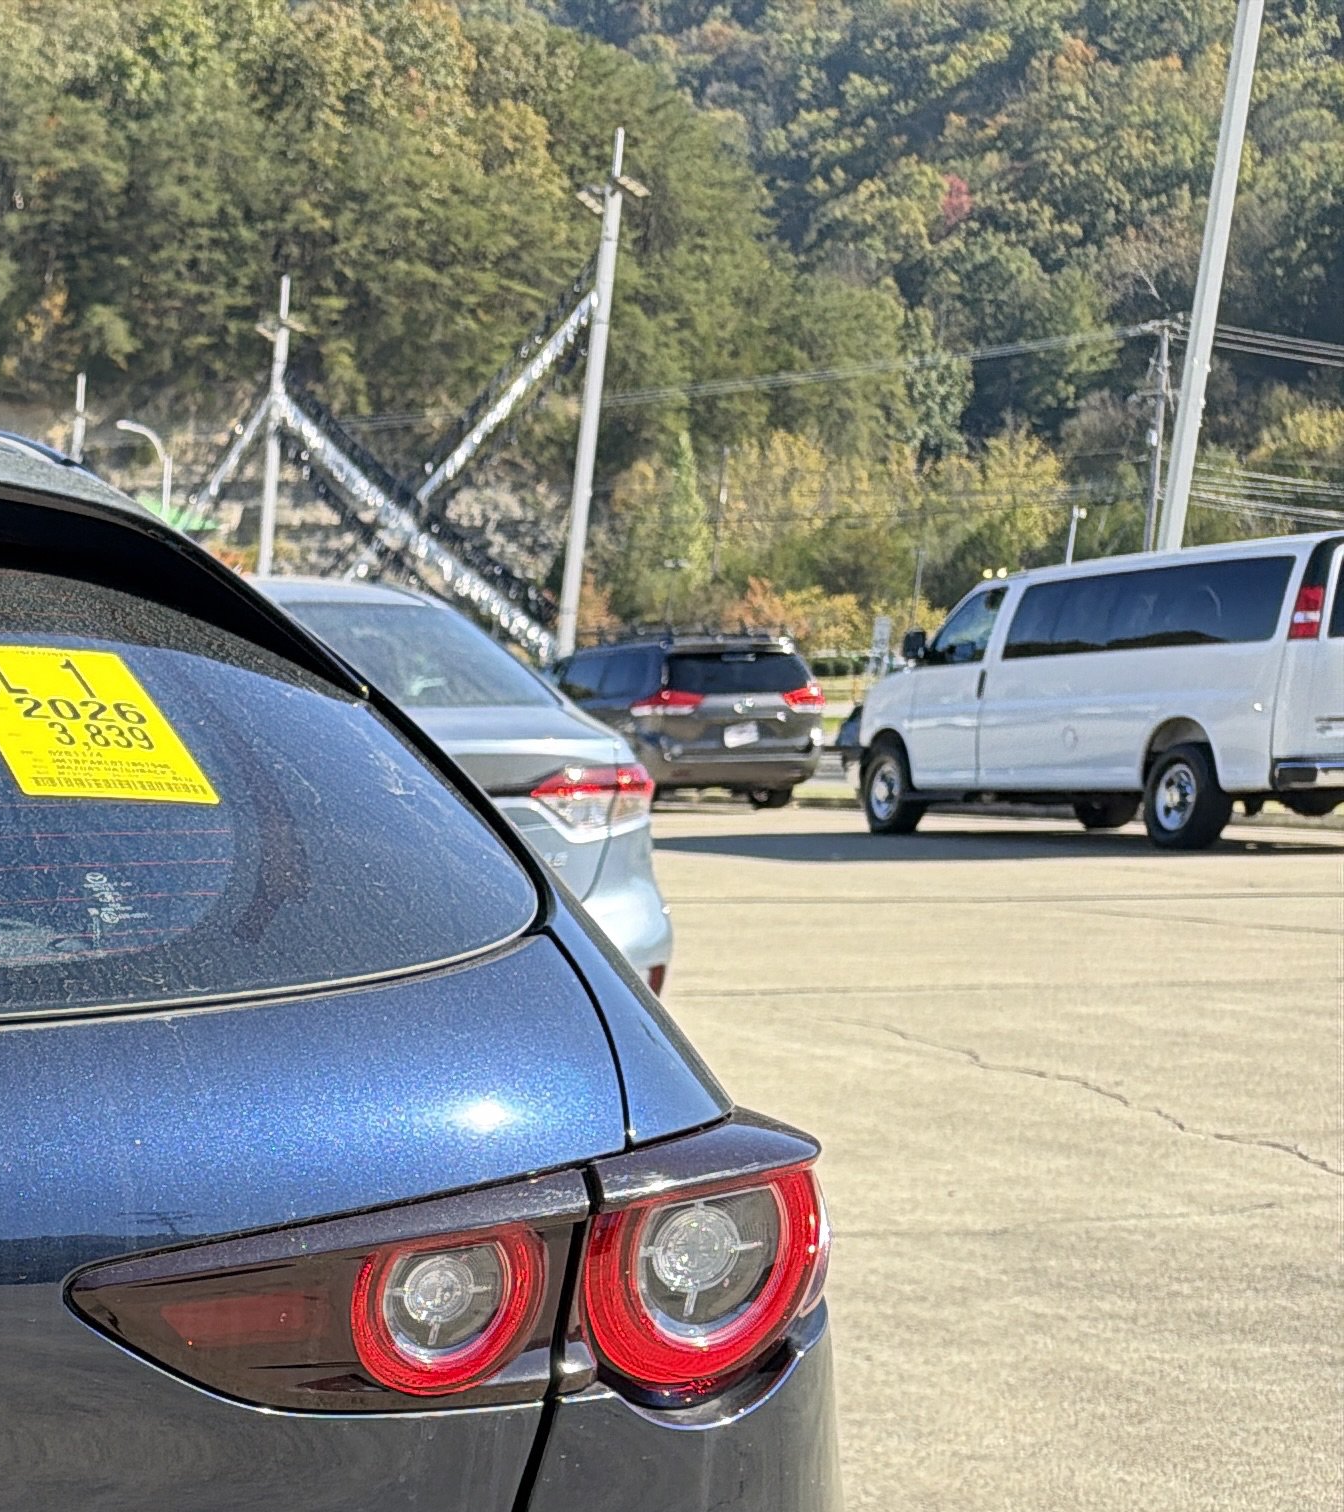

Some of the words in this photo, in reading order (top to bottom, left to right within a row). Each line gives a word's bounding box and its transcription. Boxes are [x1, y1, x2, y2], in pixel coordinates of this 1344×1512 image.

[59, 659, 97, 698] 1
[15, 697, 148, 725] 2026
[48, 722, 155, 751] 3,839
